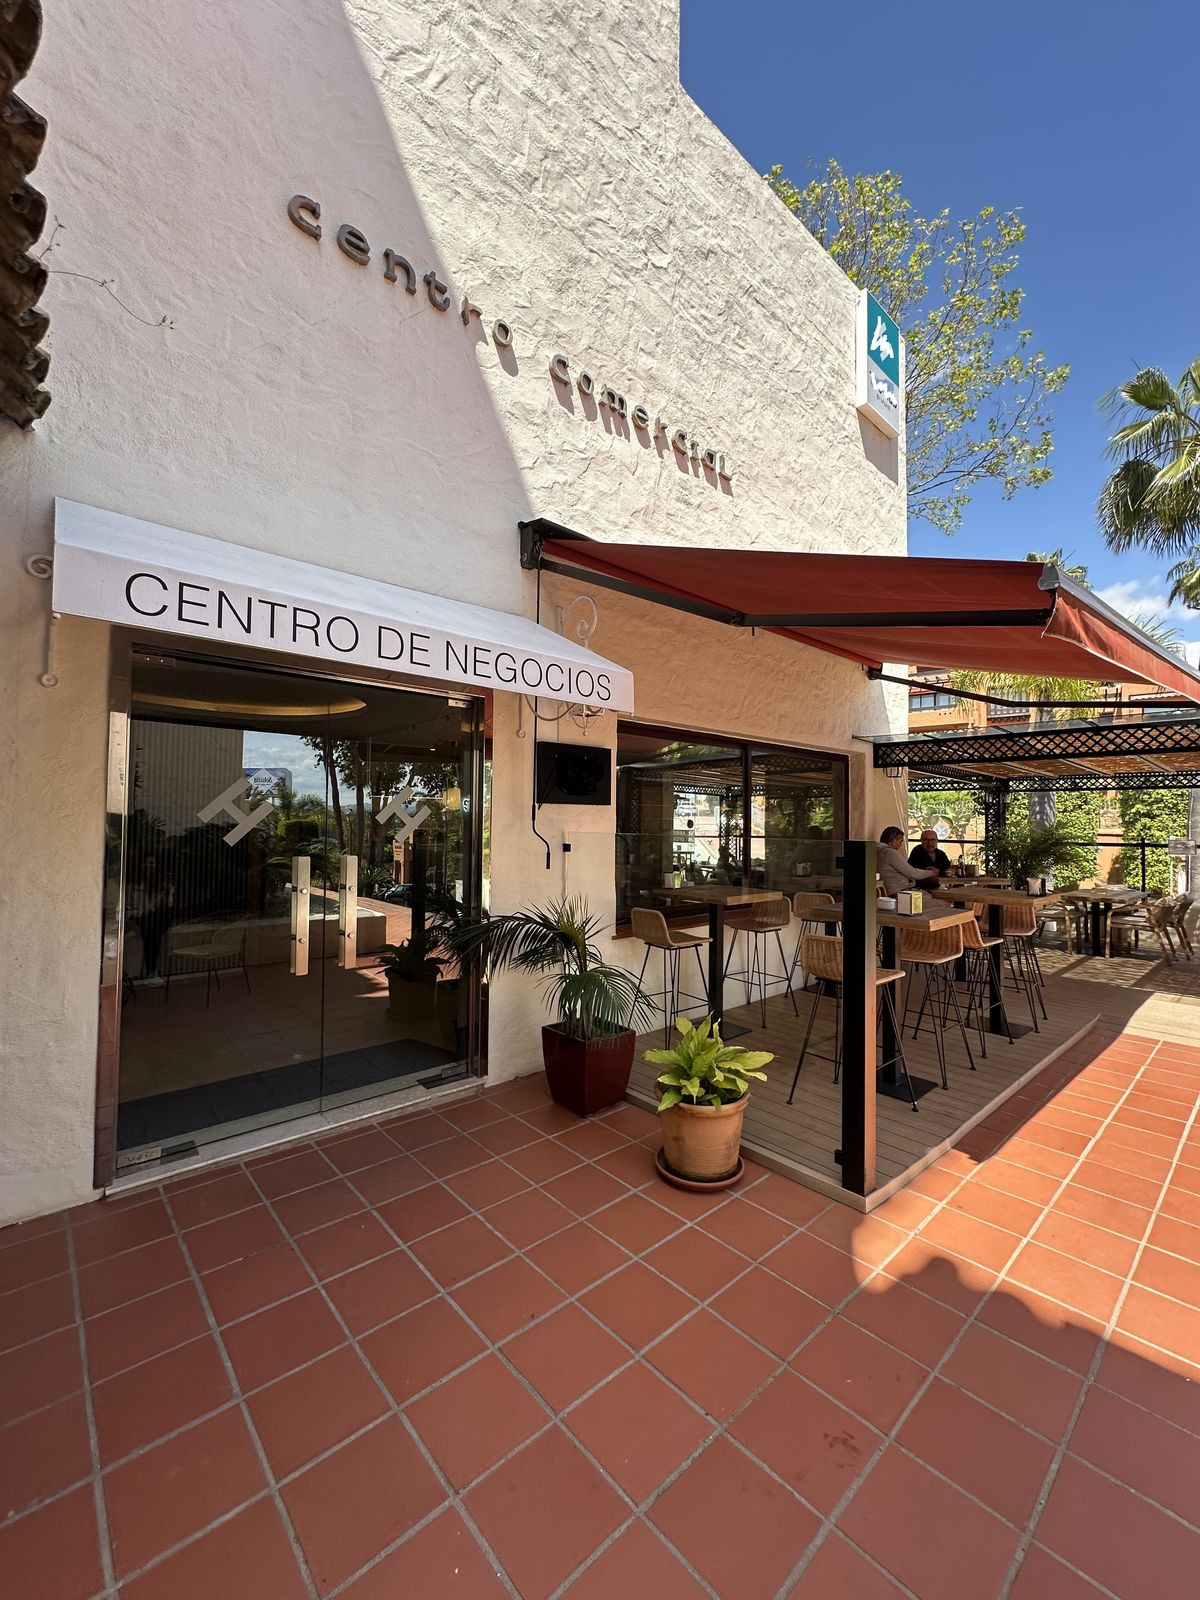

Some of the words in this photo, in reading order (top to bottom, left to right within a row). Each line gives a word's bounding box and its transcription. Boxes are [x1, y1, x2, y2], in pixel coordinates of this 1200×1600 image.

[125, 572, 360, 653] CENTRO
[377, 626, 431, 668] DE
[445, 640, 612, 701] NEGOCIOS
